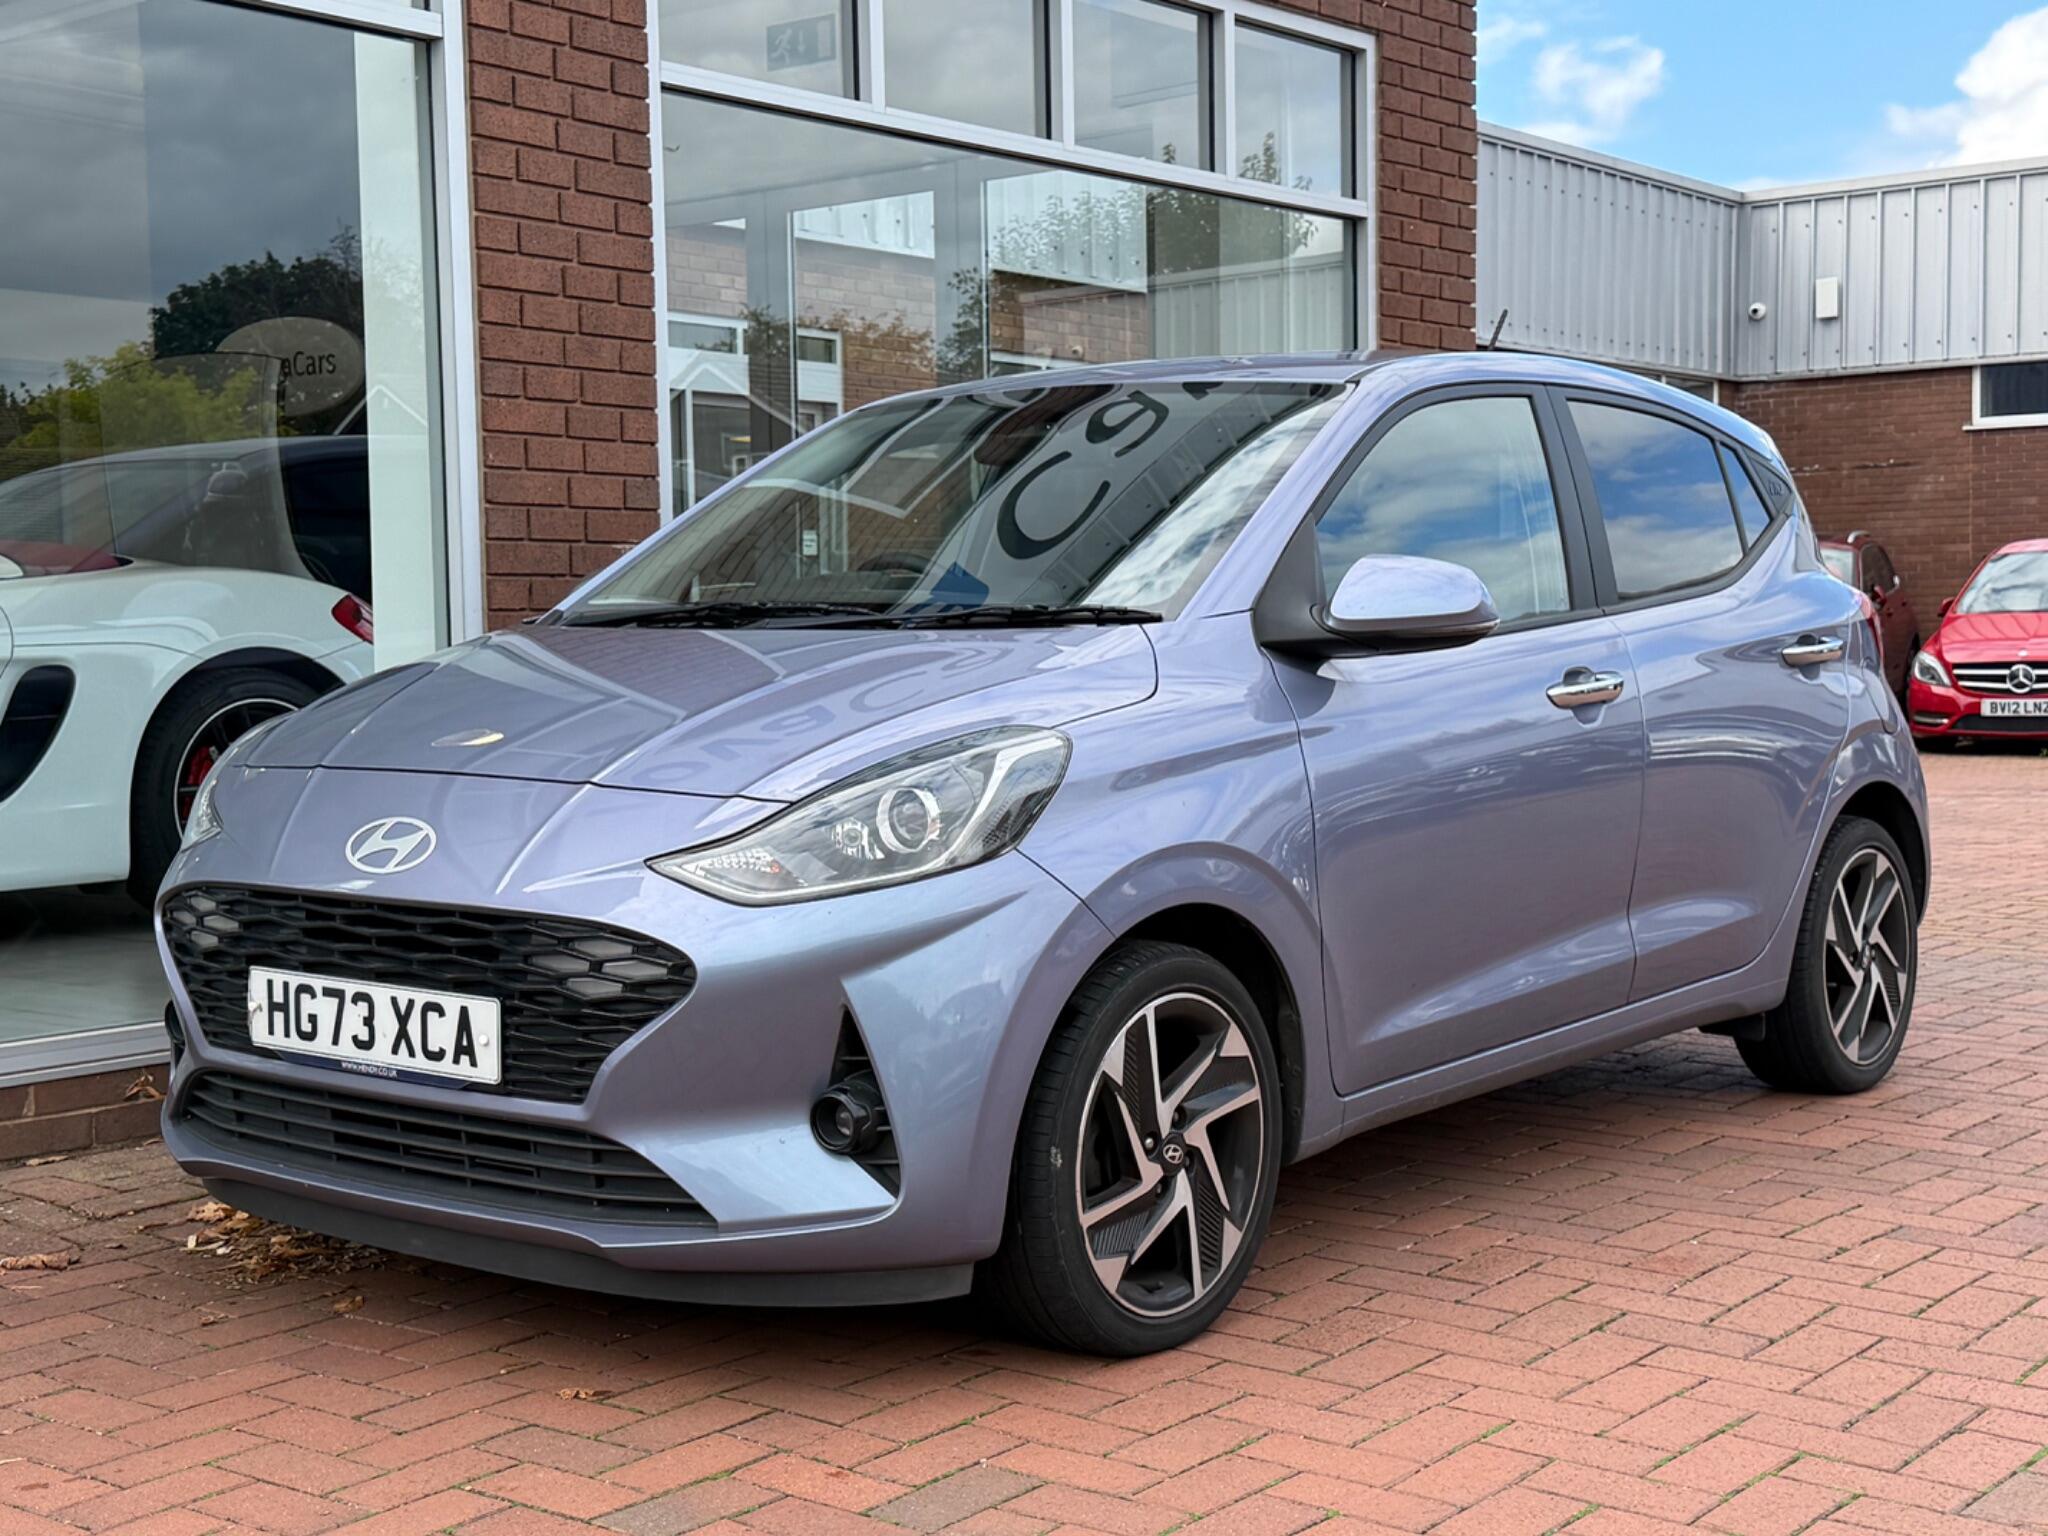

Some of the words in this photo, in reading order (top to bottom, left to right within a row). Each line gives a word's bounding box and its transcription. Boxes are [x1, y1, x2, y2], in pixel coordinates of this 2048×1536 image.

[1990, 701, 2020, 714] BV12
[266, 978, 376, 1051] HG73
[389, 995, 478, 1068] XCA
